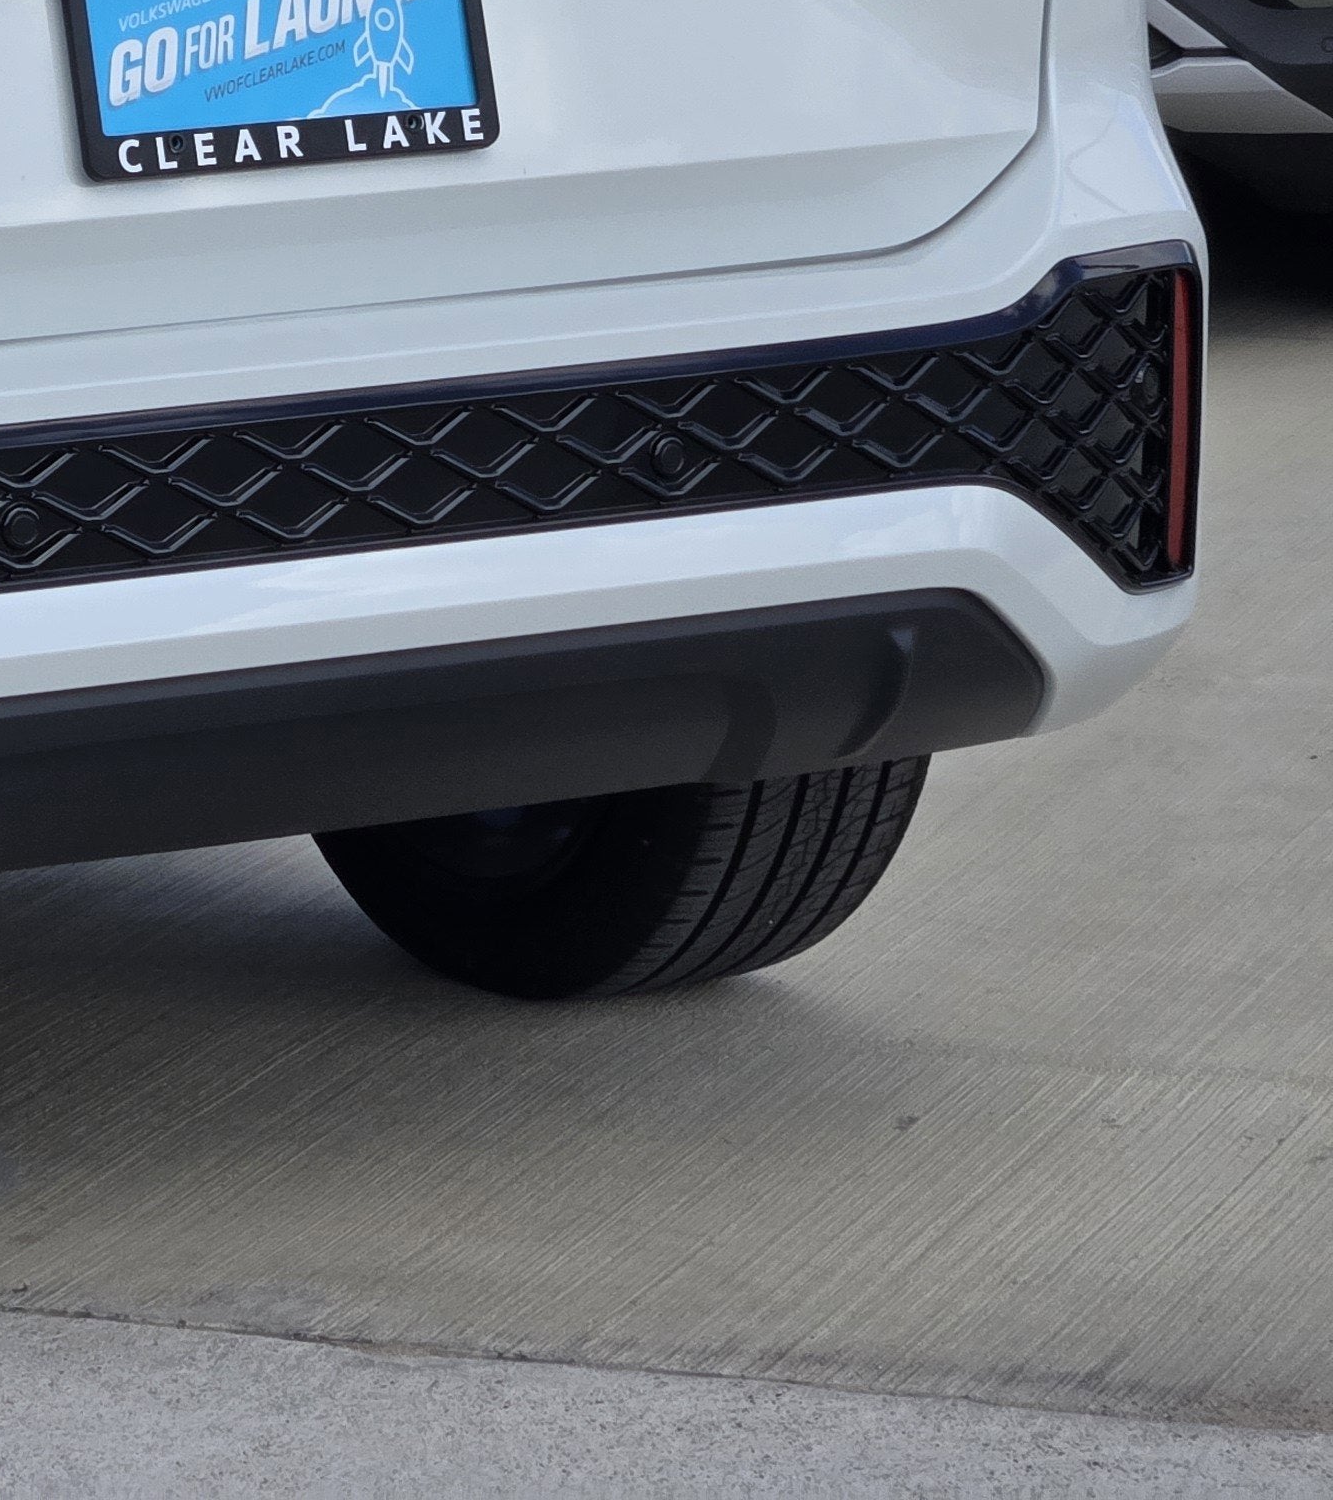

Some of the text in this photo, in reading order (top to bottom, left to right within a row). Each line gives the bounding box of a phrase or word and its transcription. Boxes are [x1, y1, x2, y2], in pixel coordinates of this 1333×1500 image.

[108, 26, 179, 108] GO
[184, 14, 235, 77] FOR
[203, 39, 347, 102] VWOFCLEARLAKE.COM
[117, 108, 485, 174] CLEAR LAKE
